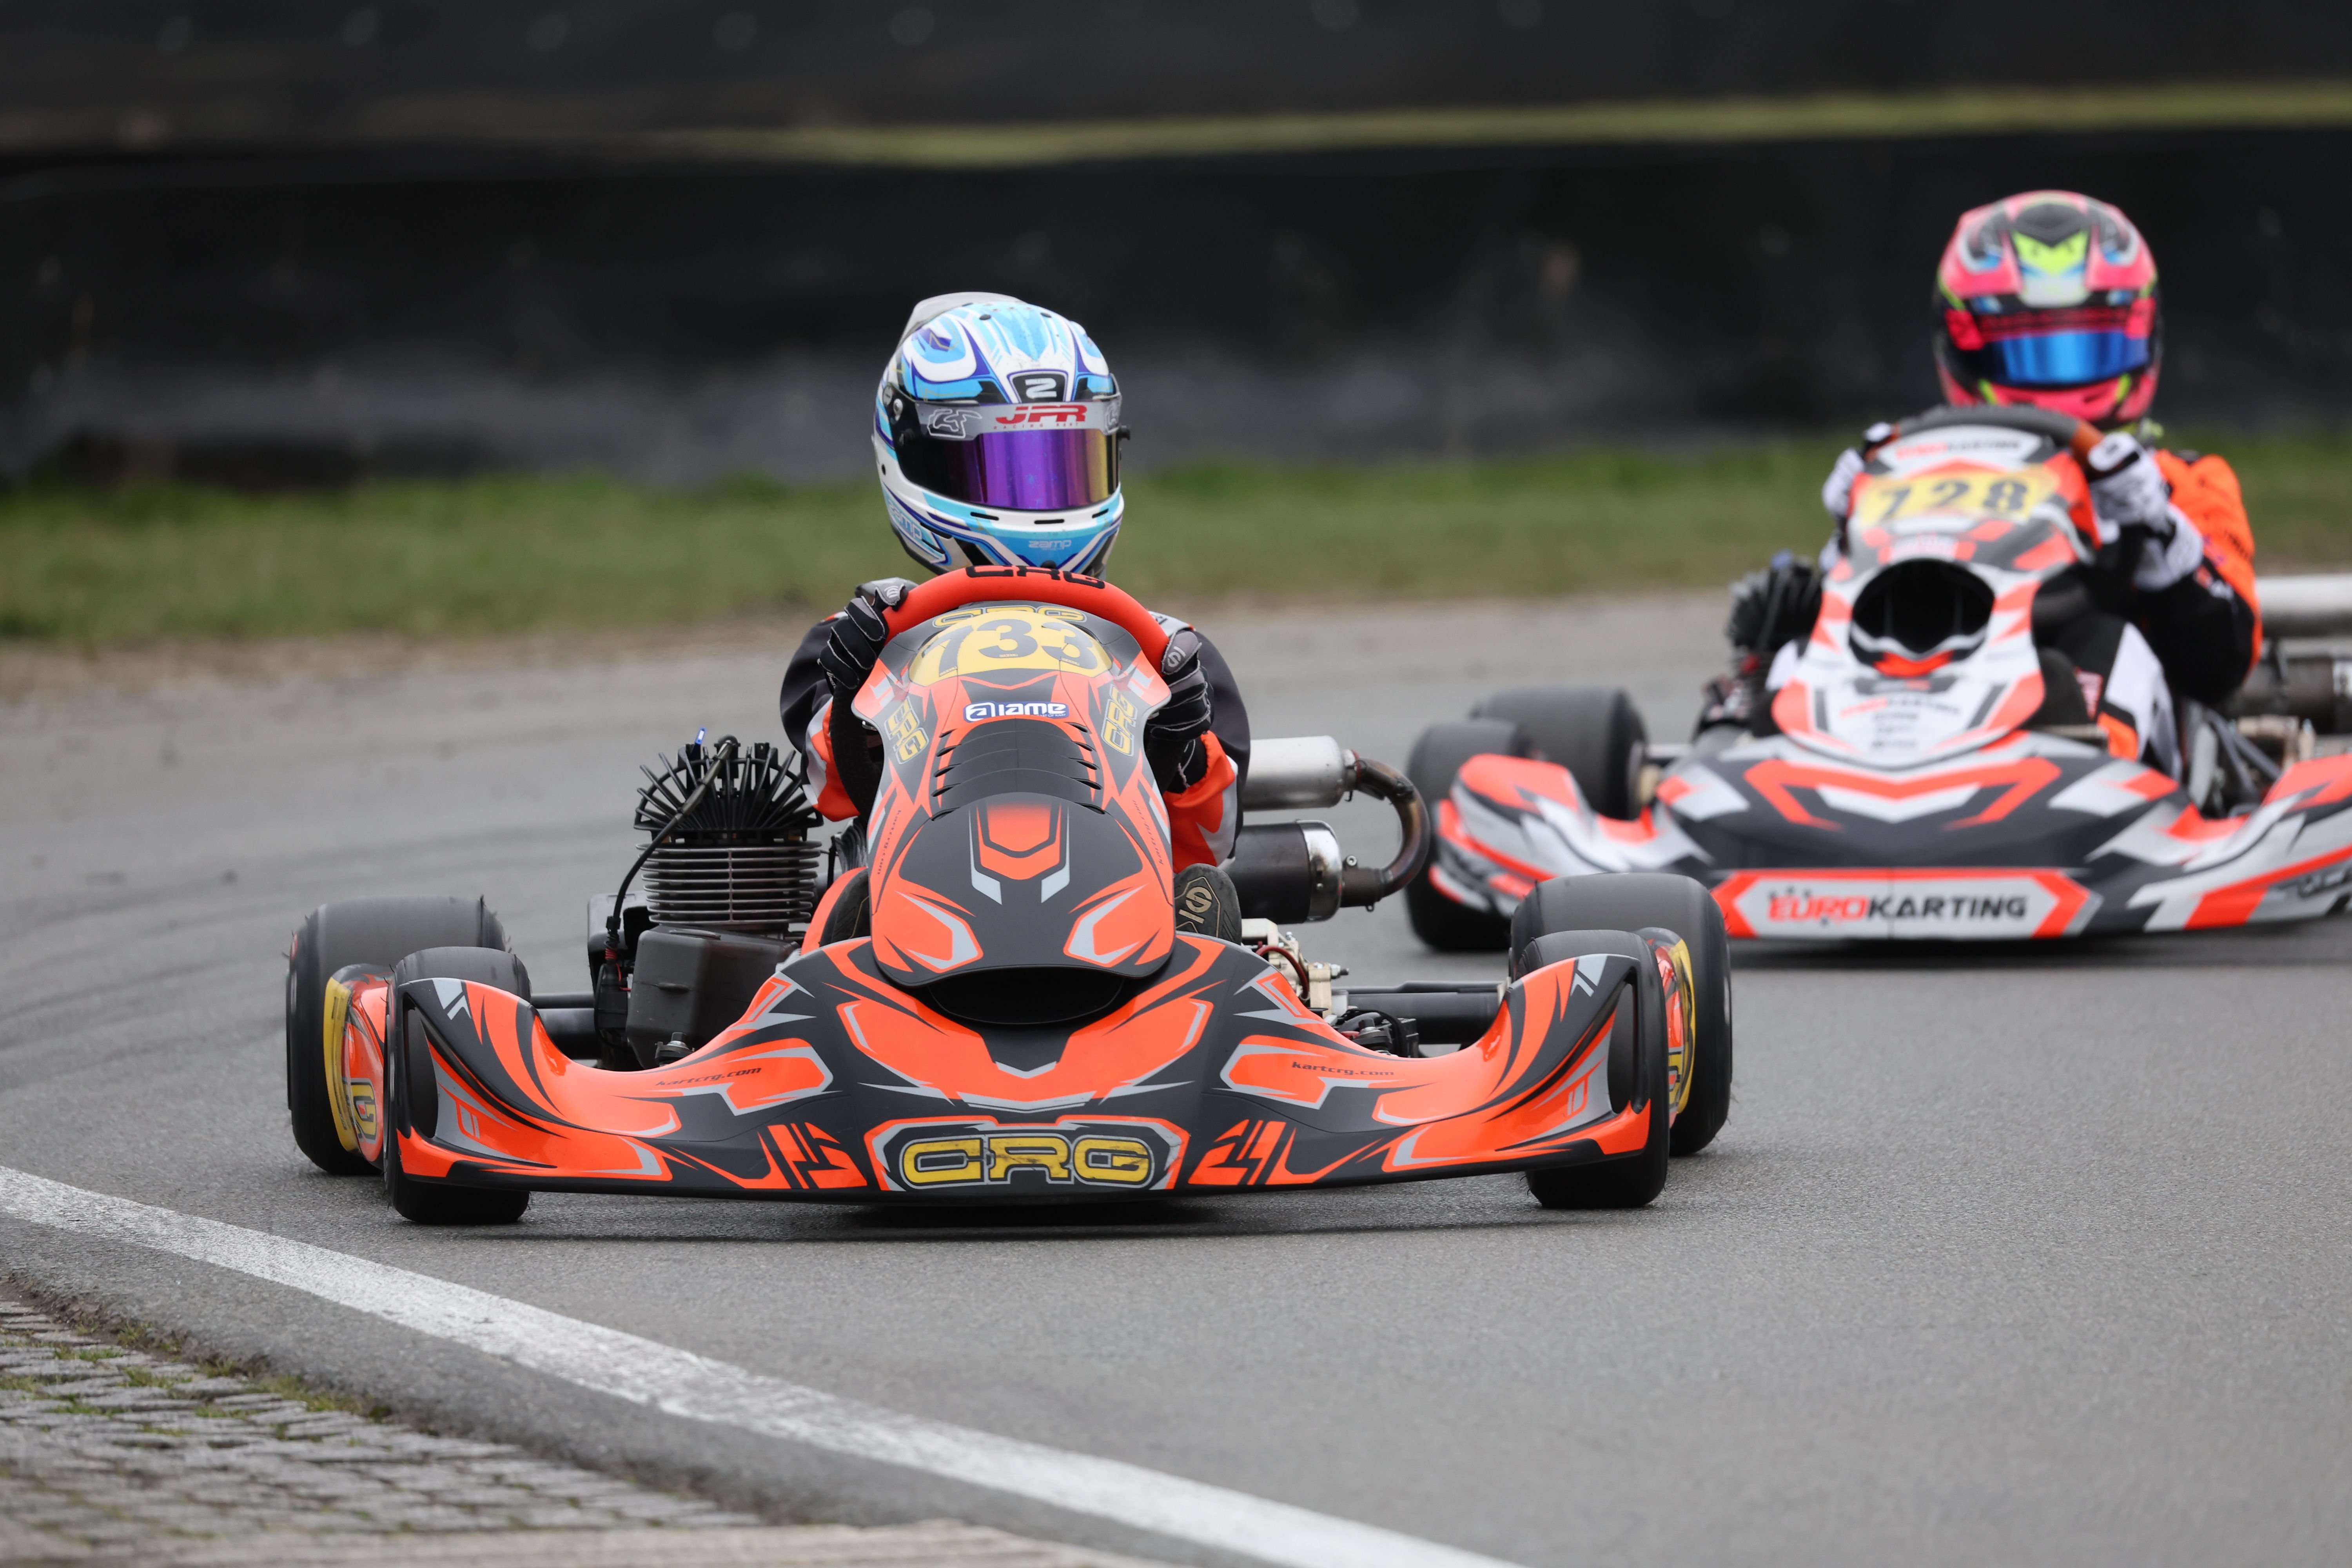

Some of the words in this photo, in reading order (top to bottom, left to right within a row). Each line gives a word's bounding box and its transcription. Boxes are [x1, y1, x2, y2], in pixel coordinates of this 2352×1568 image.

[1025, 378, 1057, 399] 2
[996, 405, 1087, 424] JPR
[1882, 478, 2028, 519] 728
[922, 619, 1098, 677] 733
[1768, 893, 2029, 922] EUROKARTING
[655, 1068, 762, 1085] kartcrg.com
[1292, 1062, 1394, 1075] kartcrg.com
[901, 1134, 1153, 1187] CRG
